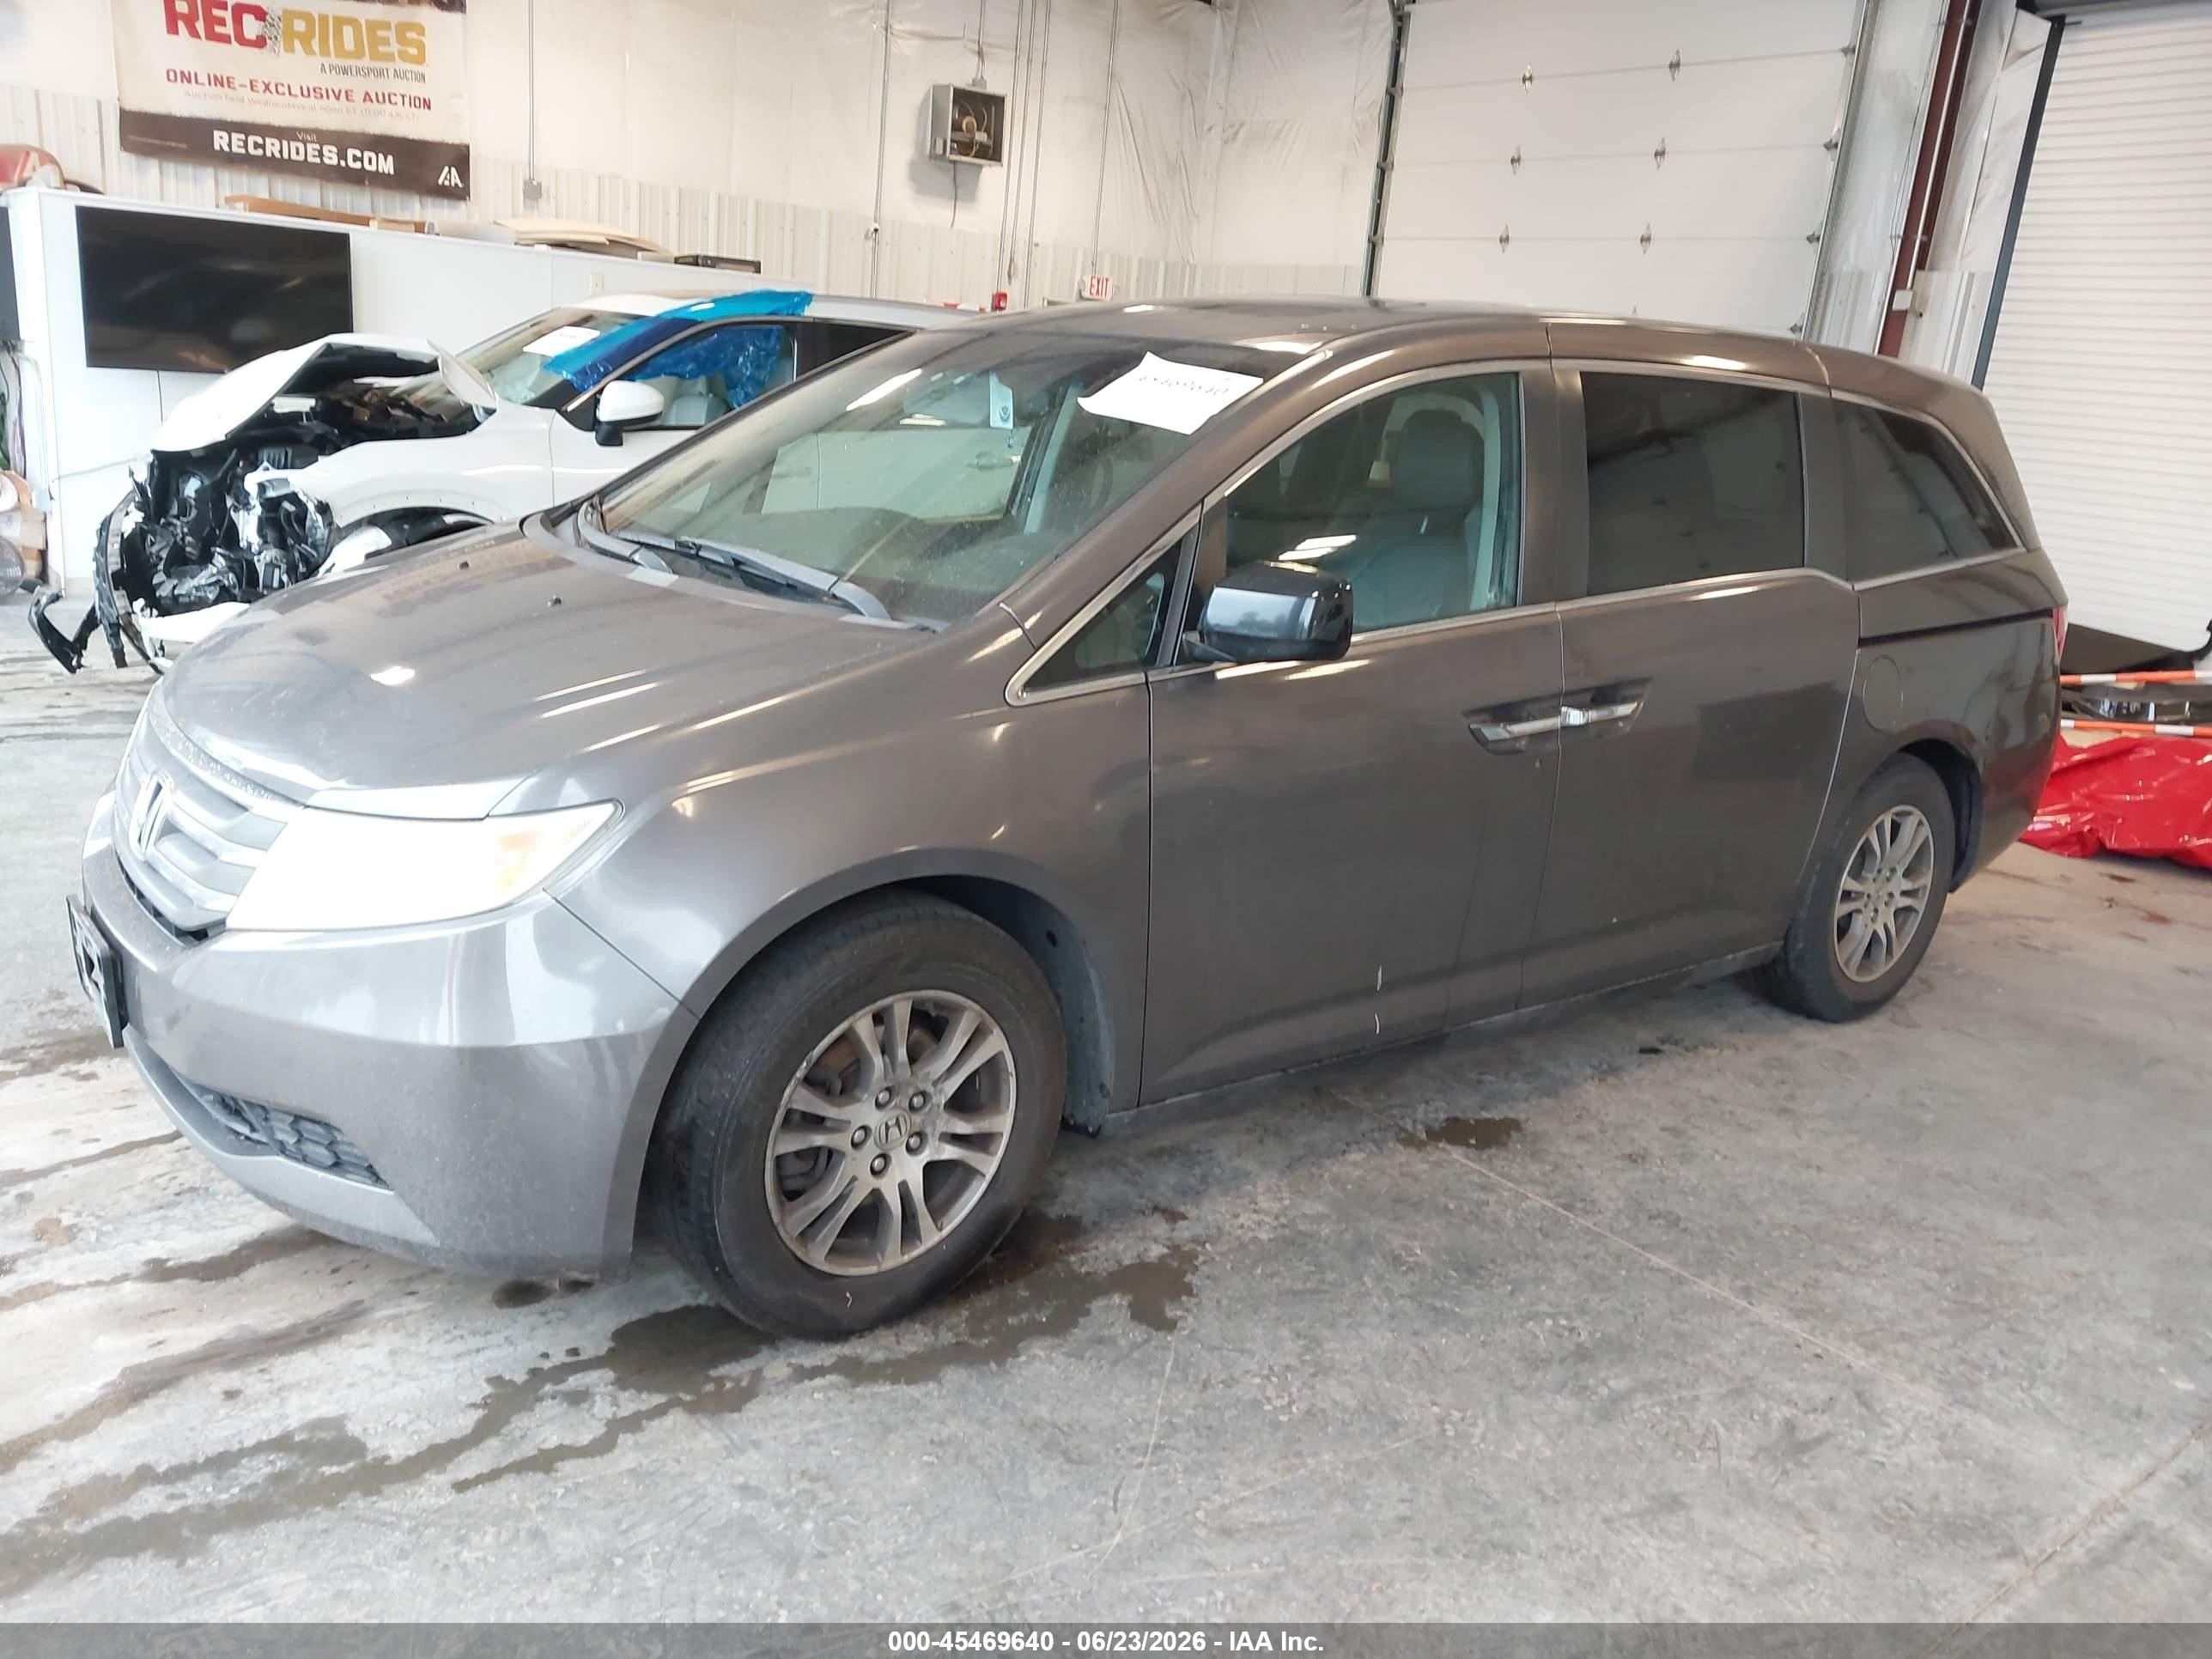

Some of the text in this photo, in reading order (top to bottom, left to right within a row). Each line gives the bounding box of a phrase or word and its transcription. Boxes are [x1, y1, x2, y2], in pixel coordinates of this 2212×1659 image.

[163, 0, 427, 65] REC RIDES
[166, 68, 433, 111] ONLINE-EXCLUSIVE AUCTION
[320, 63, 427, 84] A POWERSPORT AUCTION
[213, 130, 395, 175] RECRIDES.COM
[296, 131, 317, 143] Visit
[1090, 275, 1109, 298] EXIT
